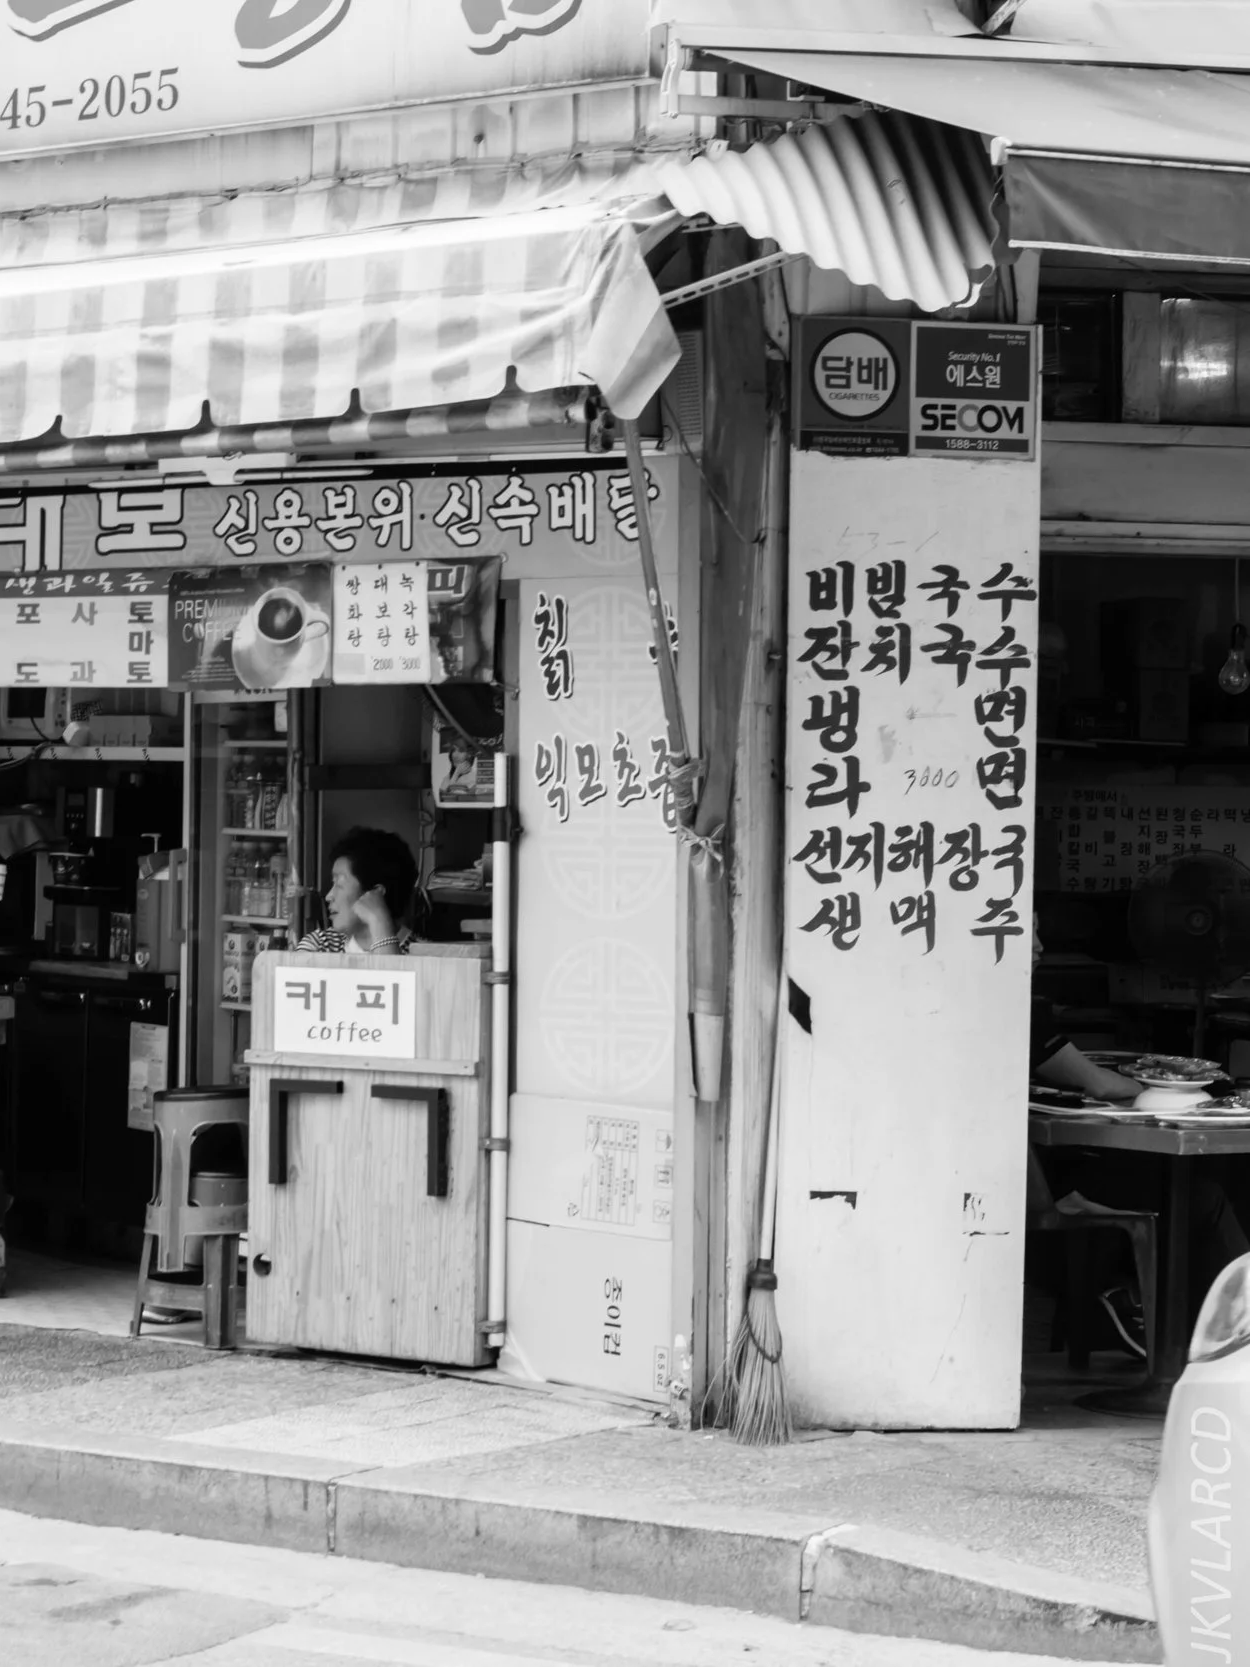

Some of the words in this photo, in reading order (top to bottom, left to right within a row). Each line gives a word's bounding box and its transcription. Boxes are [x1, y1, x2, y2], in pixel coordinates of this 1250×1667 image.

[948, 351, 980, 363] Security
[821, 356, 888, 391] 담배
[946, 364, 1001, 389] 에스원
[828, 392, 880, 401] CIGARETTES
[920, 404, 1025, 434] SECOM
[945, 439, 999, 450] 1588-3112
[806, 559, 1038, 622] 비빔국수
[796, 620, 1034, 690] 잔치국수
[793, 820, 1027, 899] 선지해장국
[285, 980, 400, 1026] 커피
[307, 1020, 383, 1043] coffee
